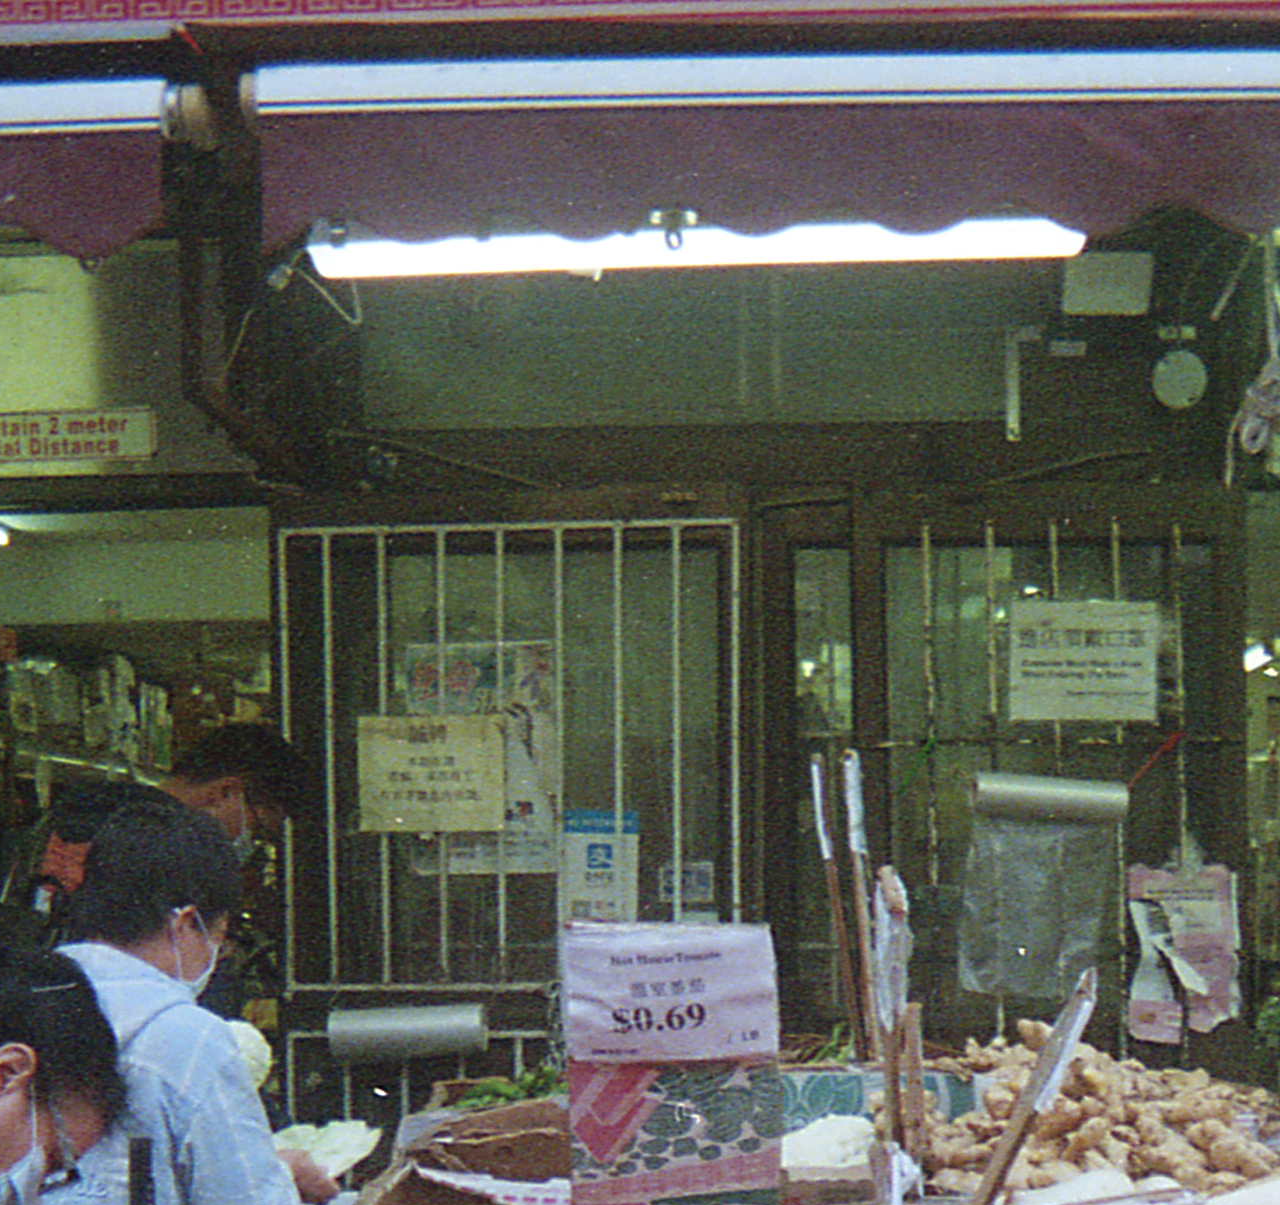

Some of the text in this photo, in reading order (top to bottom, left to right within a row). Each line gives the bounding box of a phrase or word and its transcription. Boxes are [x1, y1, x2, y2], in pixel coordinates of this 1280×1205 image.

[48, 416, 60, 436] 2
[67, 416, 129, 435] meter
[29, 436, 121, 456] Distance
[610, 951, 723, 967] Hot House Tomato
[610, 1002, 707, 1035] $0.69
